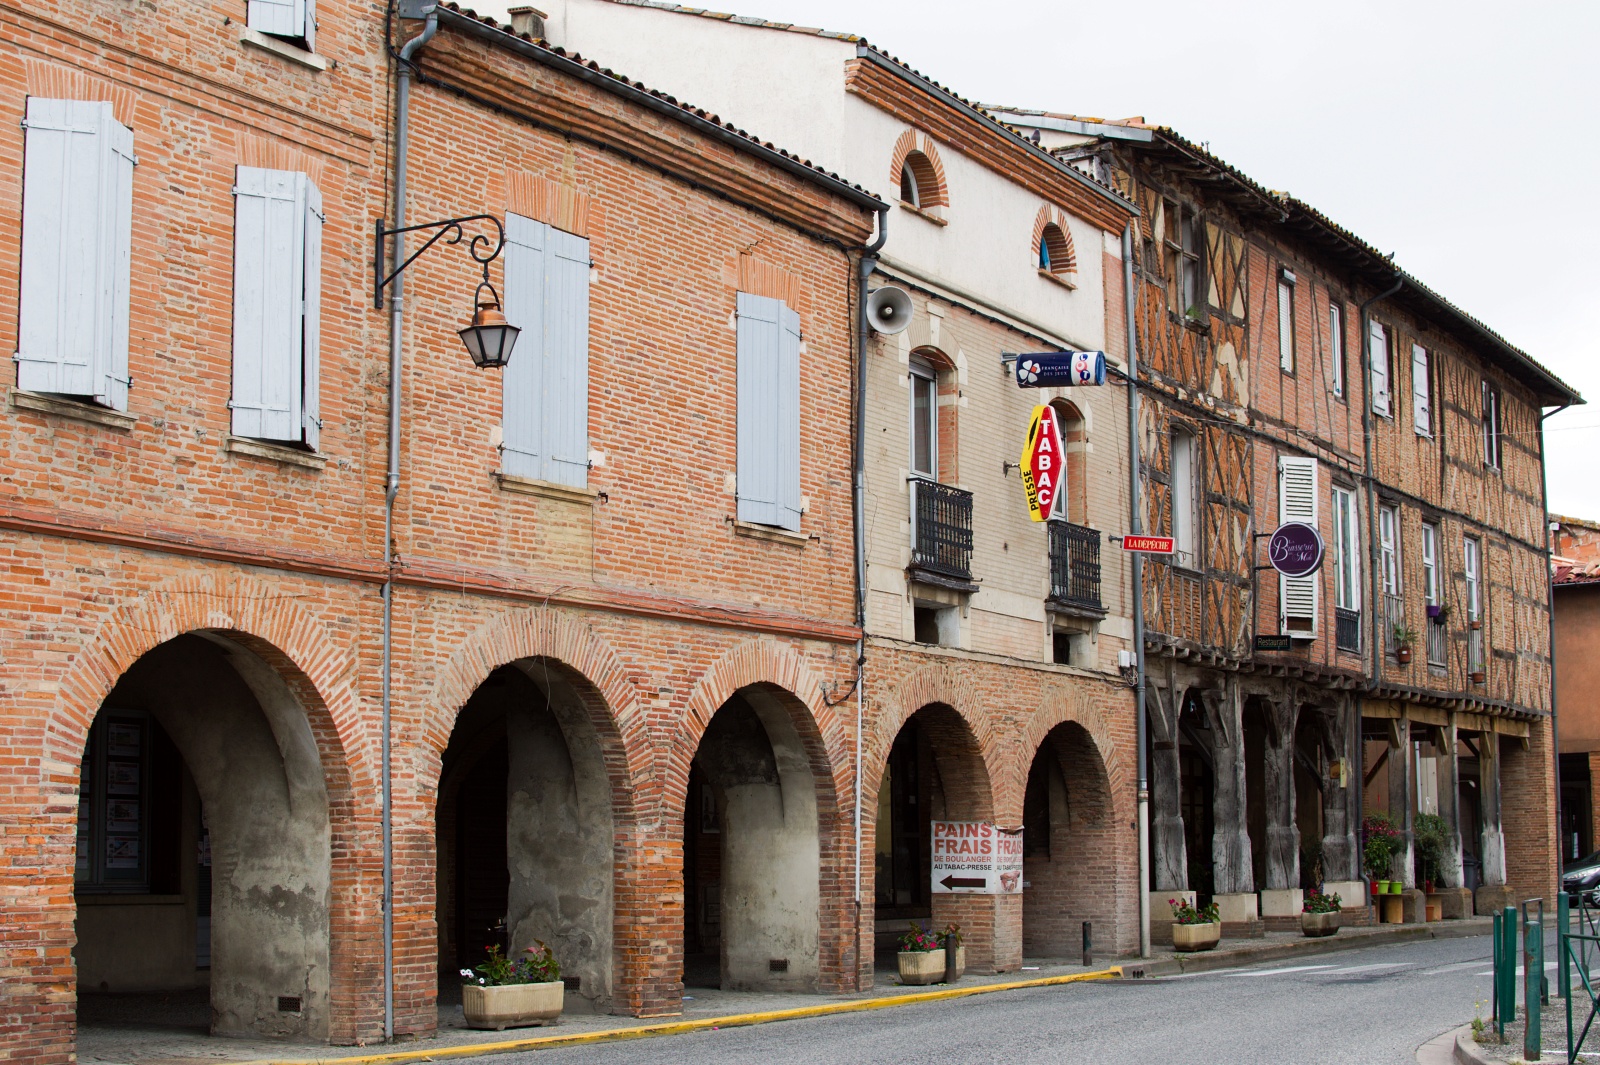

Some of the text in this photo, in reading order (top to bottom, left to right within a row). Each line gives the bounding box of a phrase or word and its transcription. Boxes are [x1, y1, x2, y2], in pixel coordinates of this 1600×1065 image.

[1037, 420, 1052, 505] TABAC
[1023, 470, 1039, 511] PRESSE
[1128, 539, 1137, 548] LA
[1272, 535, 1314, 562] Brasserie
[1257, 637, 1288, 646] Restaurant
[934, 822, 993, 838] PAINS
[934, 839, 992, 854] FRAIS
[945, 855, 992, 863] BOULANGER
